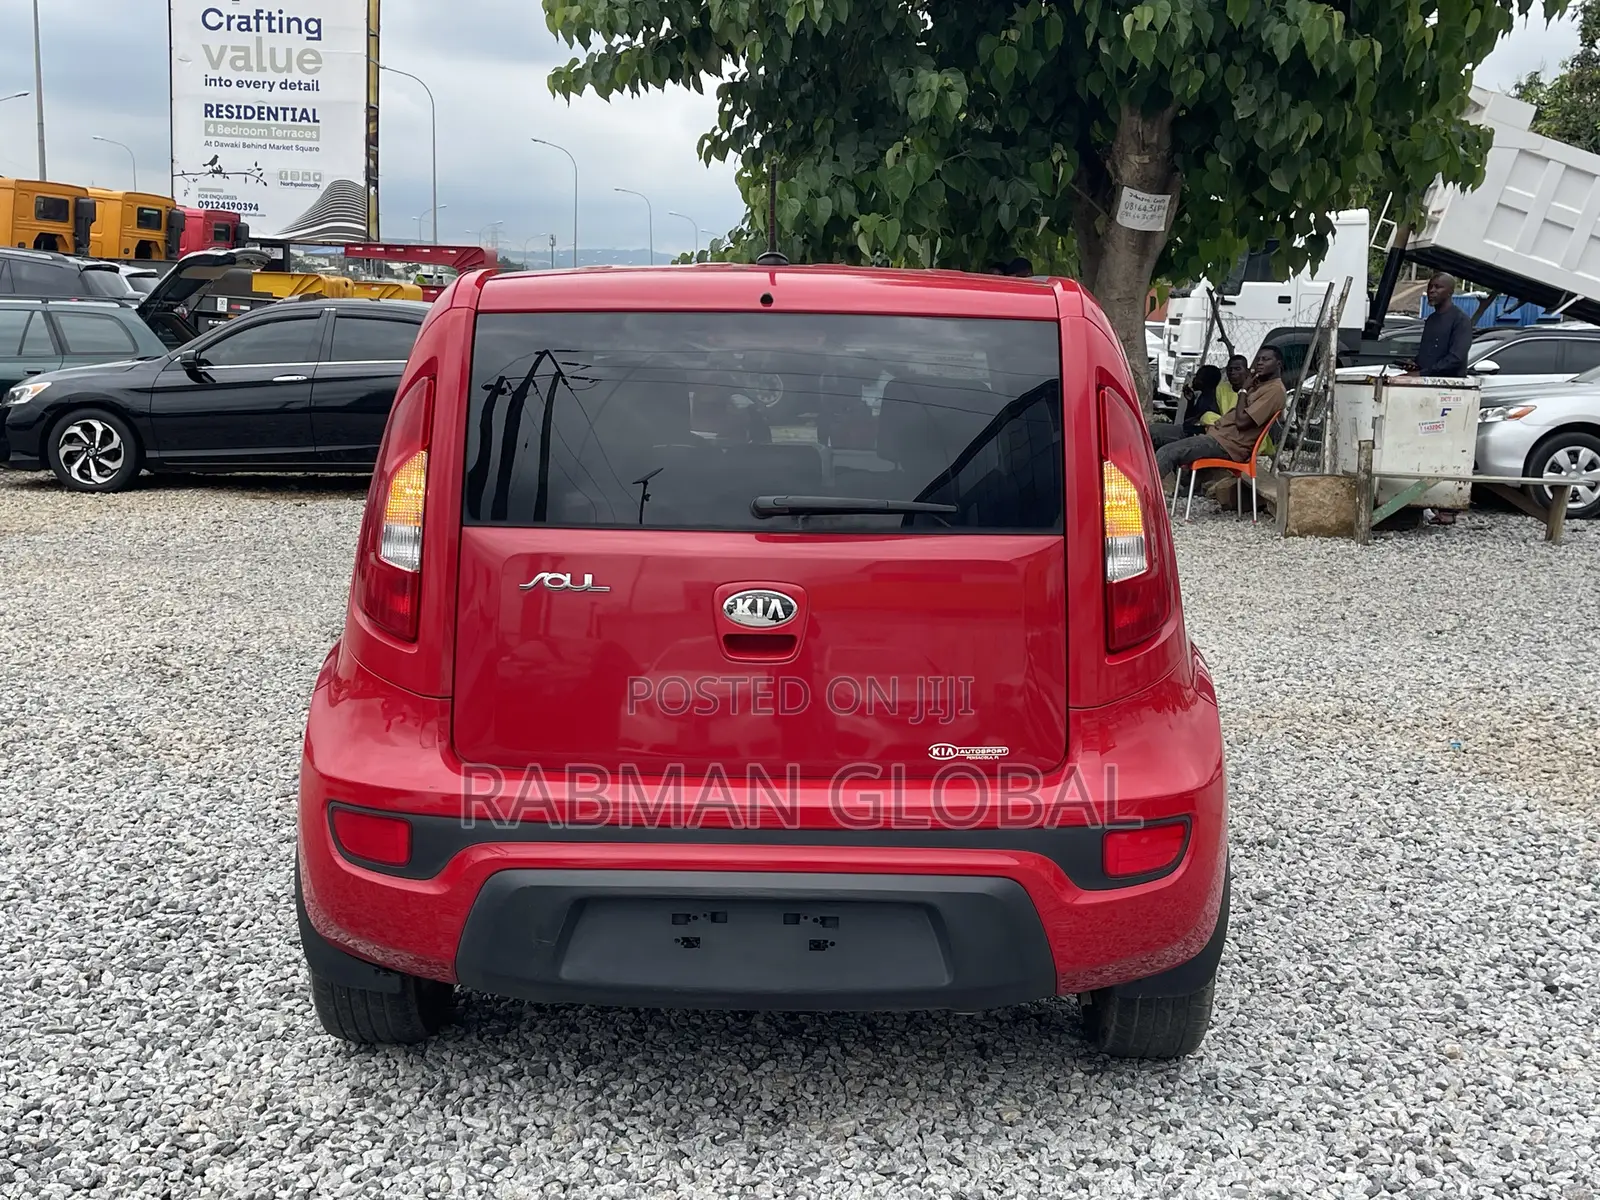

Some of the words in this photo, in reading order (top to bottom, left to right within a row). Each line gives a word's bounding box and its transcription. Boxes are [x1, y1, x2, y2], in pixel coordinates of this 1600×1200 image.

[201, 7, 322, 41] Crafting
[201, 36, 323, 75] value
[204, 74, 232, 88] into
[236, 77, 275, 92] every
[279, 78, 320, 92] detail
[204, 103, 320, 123] RESIDENTIAL
[207, 125, 215, 133] 4
[217, 124, 268, 136] Bedroom
[271, 127, 317, 139] Terraces
[214, 140, 241, 149] Dawaki
[242, 141, 267, 150] Behind
[268, 143, 294, 151] Market
[295, 144, 320, 153] Square
[198, 201, 259, 211] 09124190394
[519, 572, 611, 593] SOUL
[735, 597, 786, 620] KIA
[932, 747, 954, 756] KIA
